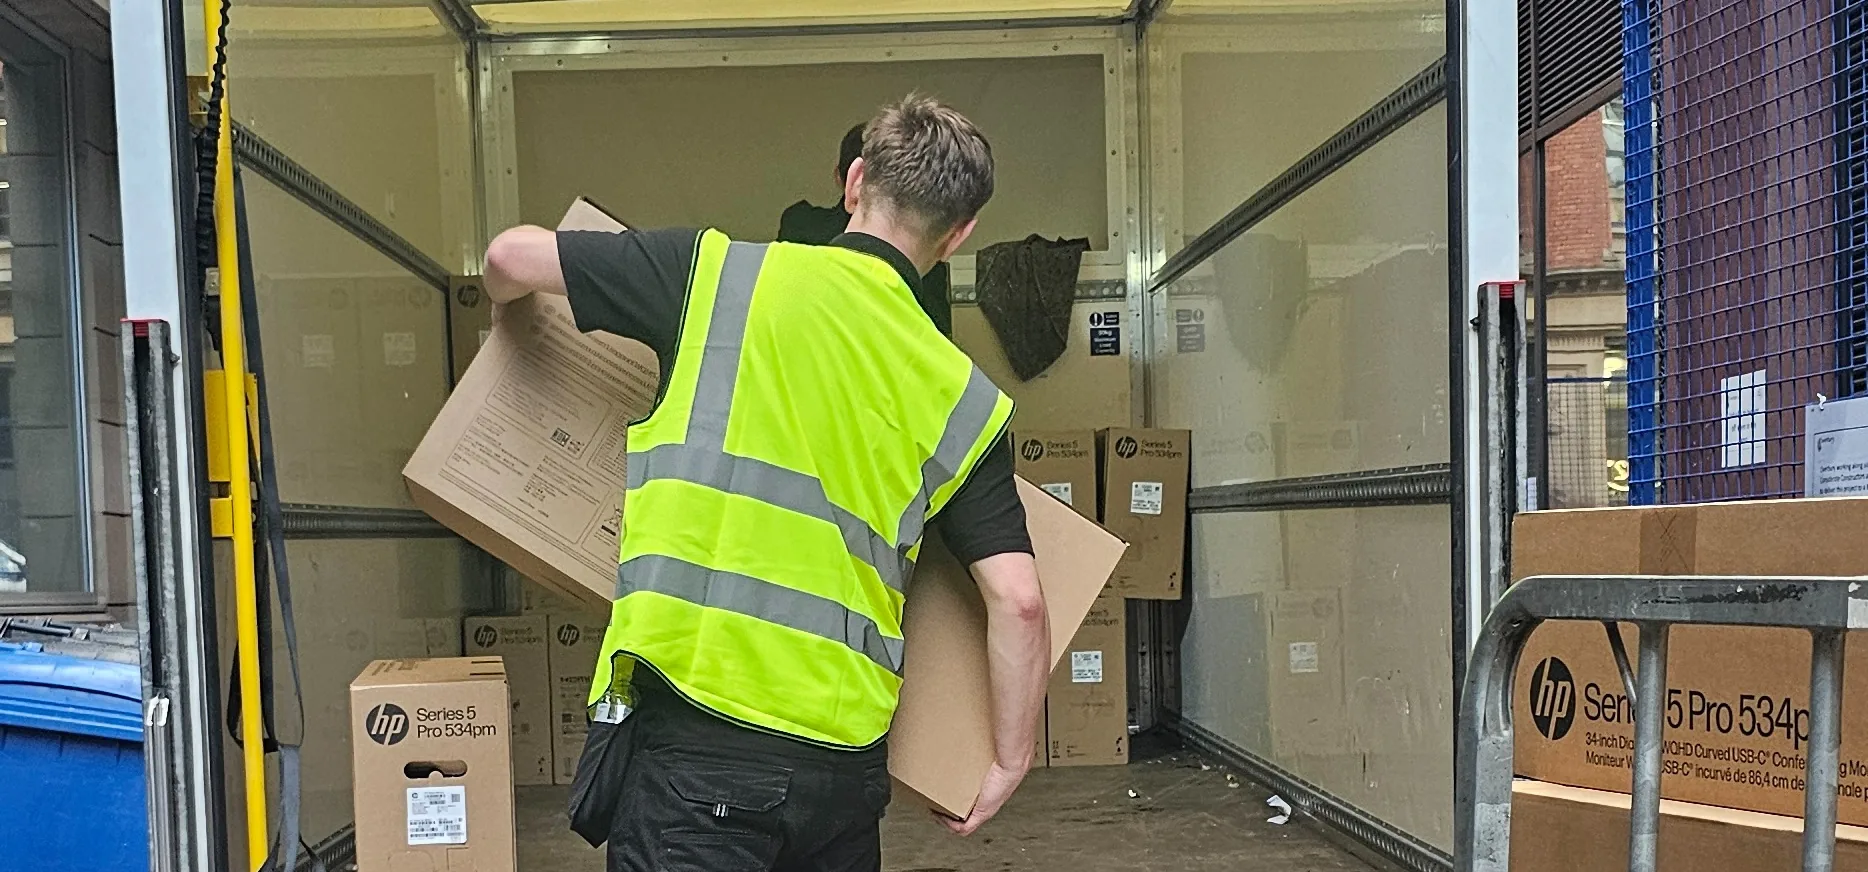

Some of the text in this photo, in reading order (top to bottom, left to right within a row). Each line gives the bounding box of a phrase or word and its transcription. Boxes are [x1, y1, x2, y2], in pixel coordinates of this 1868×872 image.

[1022, 439, 1043, 462] hp
[1116, 436, 1137, 459] hp
[475, 625, 497, 648] hp
[558, 624, 579, 646] hp
[1532, 657, 1574, 740] hp
[369, 703, 407, 745] hp
[416, 706, 476, 722] Series 5
[1584, 683, 1811, 750] Seri 5 Pro 534p
[417, 723, 497, 738] Pro 534pm
[1585, 732, 1618, 749] 34-inch
[1694, 743, 1731, 761] Curved
[1586, 751, 1625, 769] Moniteur
[1695, 763, 1732, 782] incurvé
[1733, 769, 1746, 784] de
[1748, 770, 1771, 788] 86,4
[1772, 777, 1790, 790] cm
[1791, 777, 1805, 792] de
